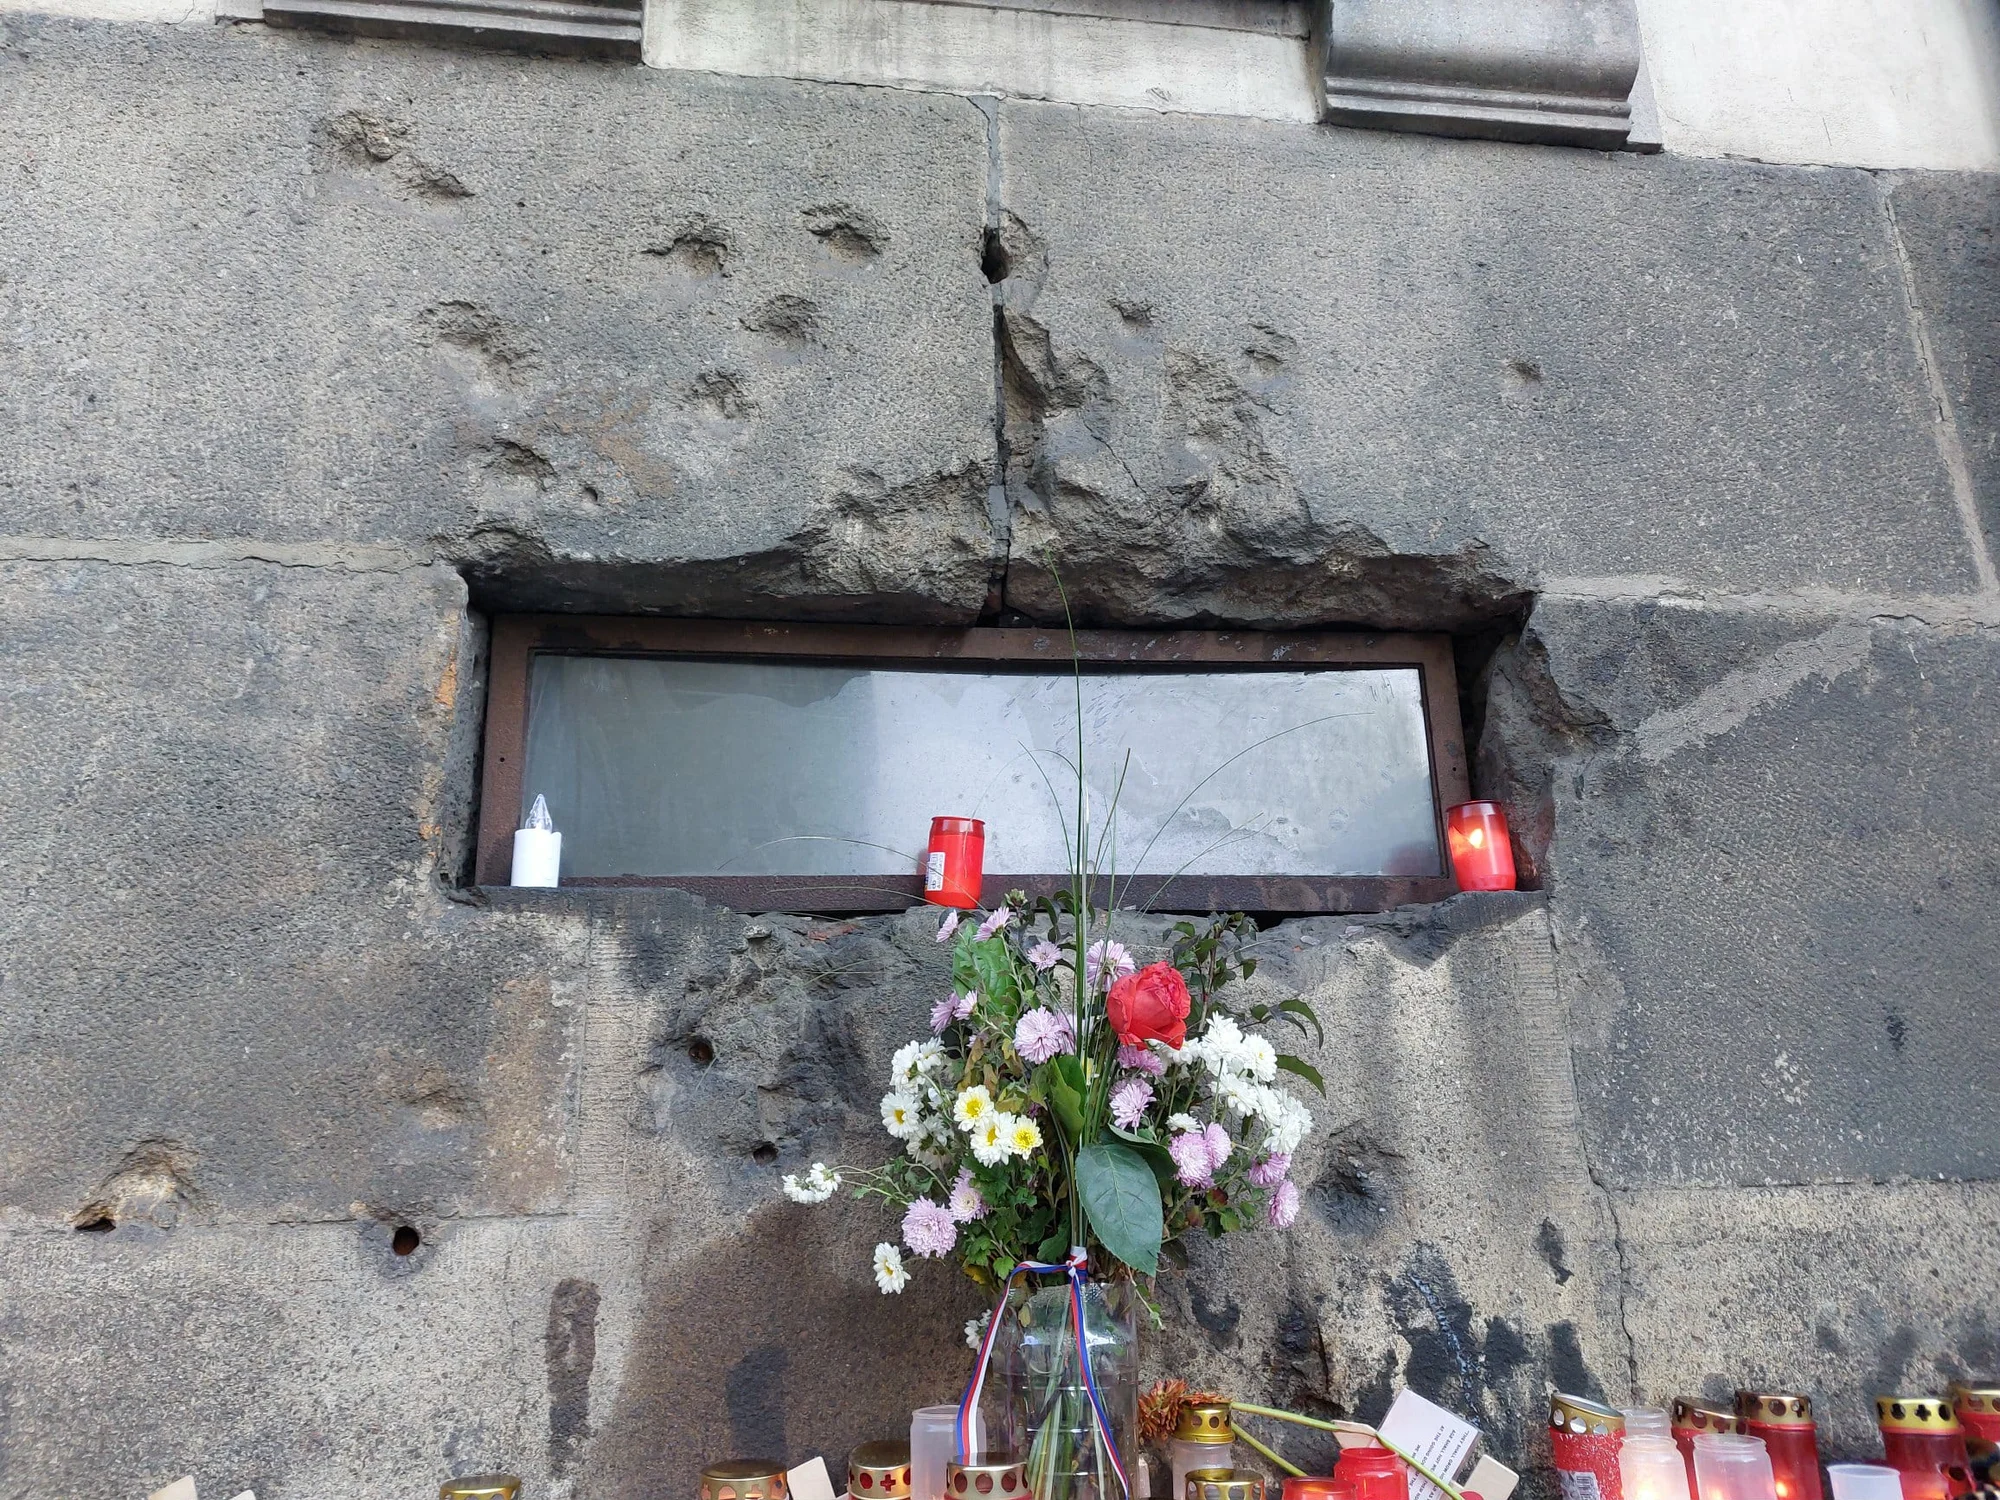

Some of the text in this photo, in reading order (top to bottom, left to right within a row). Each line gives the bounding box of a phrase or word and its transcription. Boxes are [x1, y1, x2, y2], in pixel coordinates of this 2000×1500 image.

[1425, 1441, 1436, 1457] GOING
[1441, 1440, 1451, 1454] SHALL
[1435, 1454, 1443, 1464] NOT
